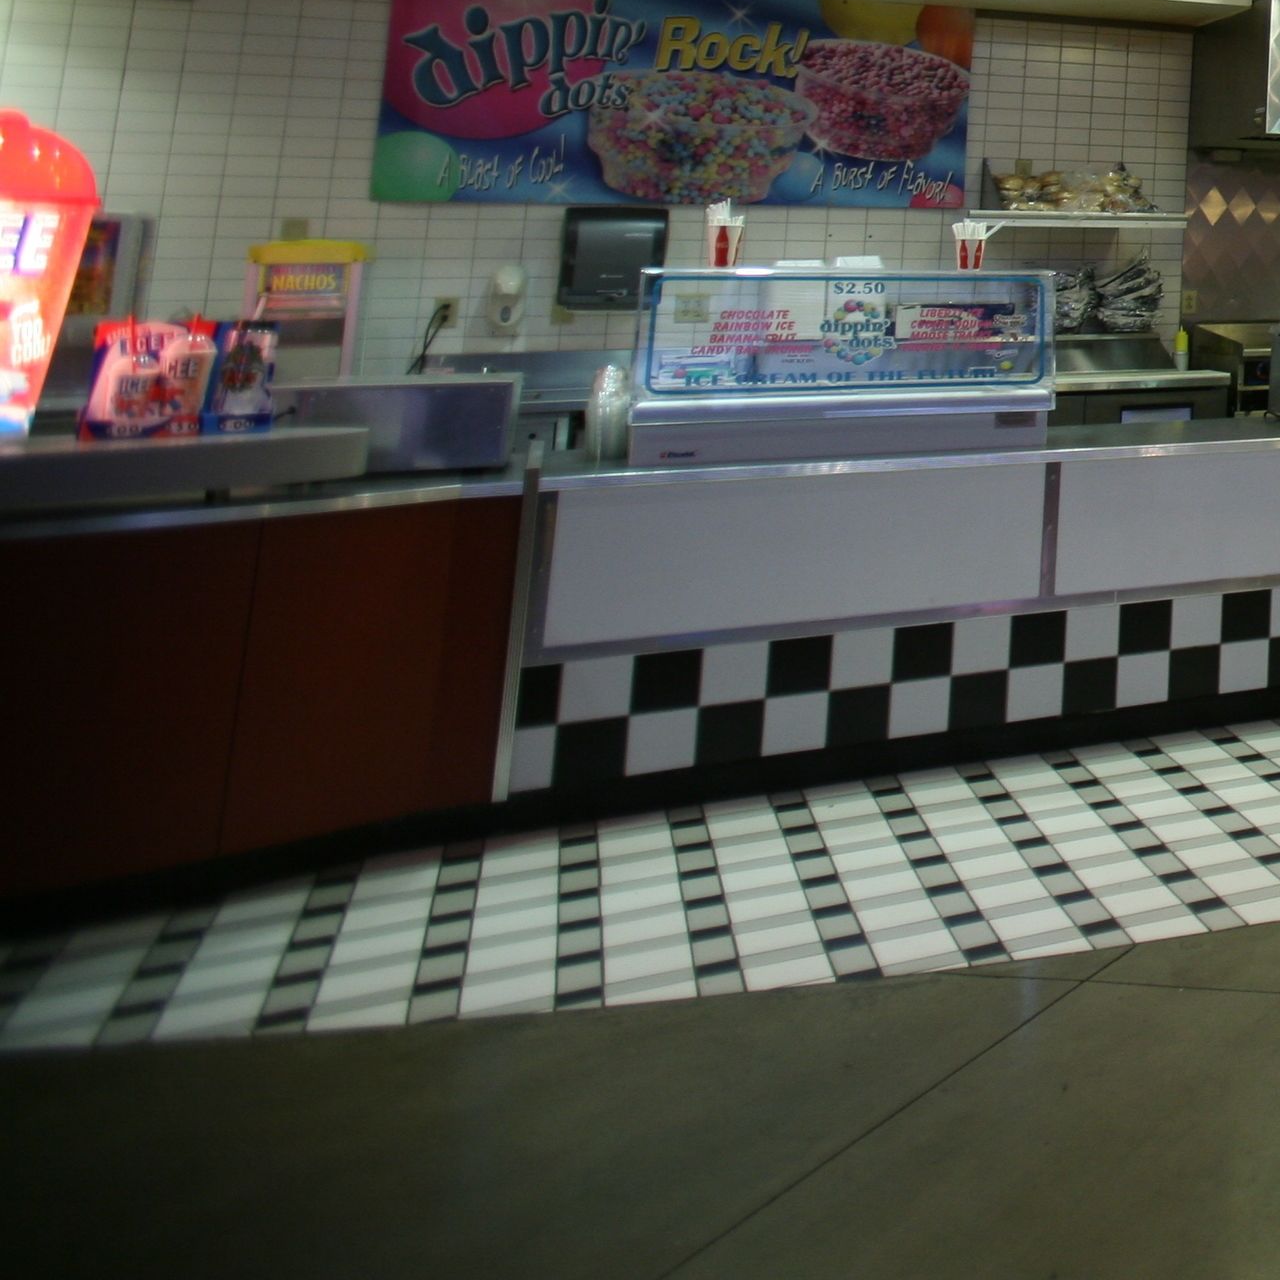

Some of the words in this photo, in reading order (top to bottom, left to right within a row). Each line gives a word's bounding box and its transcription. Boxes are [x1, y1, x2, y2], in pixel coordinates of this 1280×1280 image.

[655, 15, 809, 79] Rock!
[540, 71, 631, 118] dots
[436, 154, 452, 187] A
[810, 164, 825, 194] A
[271, 274, 338, 291] NACHOS
[833, 281, 887, 295] $2.50
[719, 309, 791, 321] CHOCOLATE
[712, 321, 773, 331] RAINBOW
[775, 321, 796, 331] ICE
[819, 318, 892, 336] dippin'
[690, 344, 732, 355] CANDY
[849, 335, 895, 349] dots
[826, 370, 857, 382] OF
